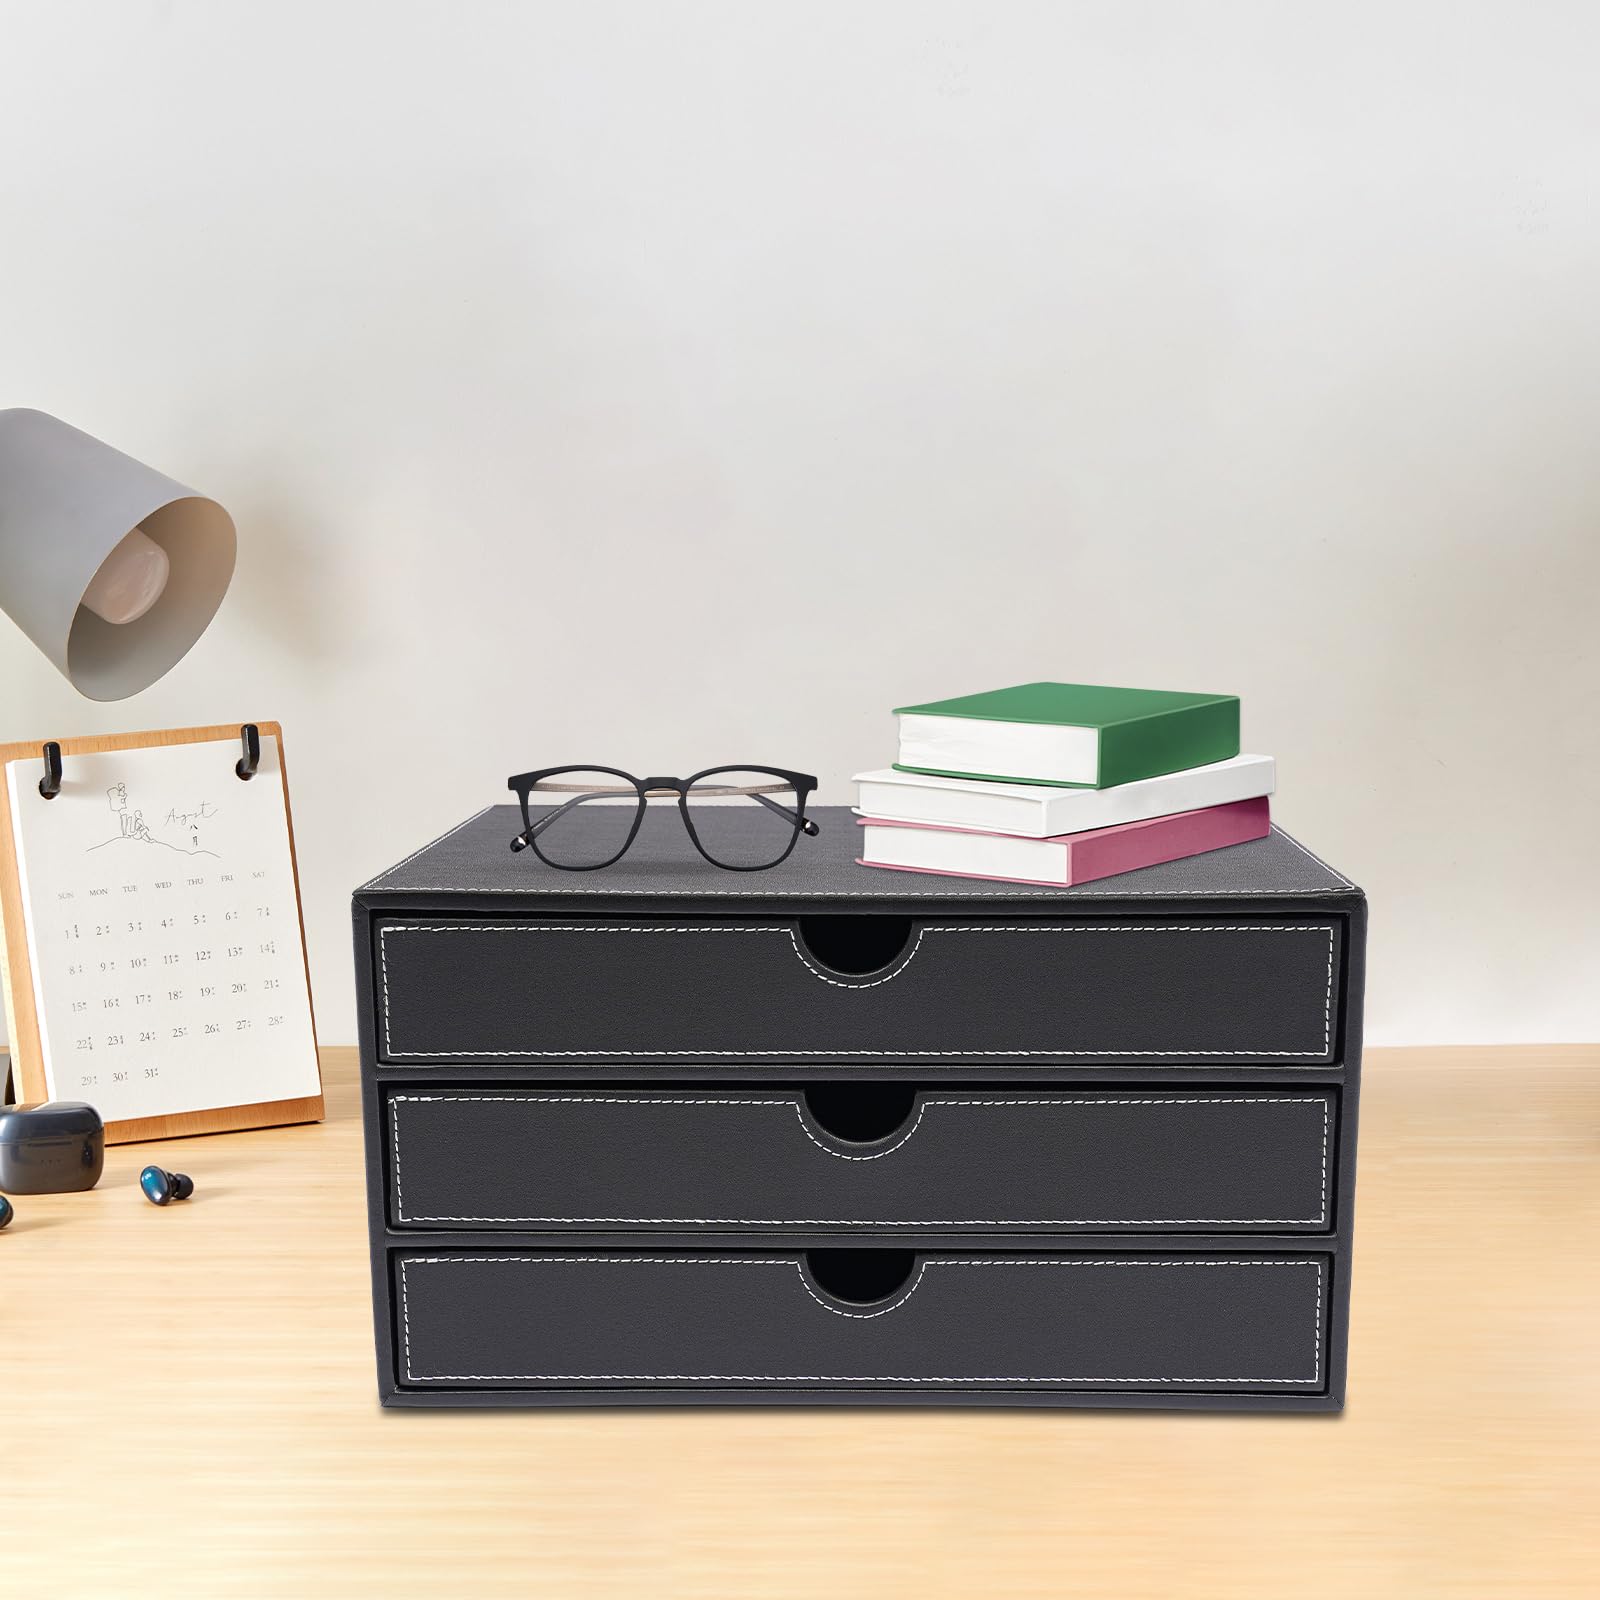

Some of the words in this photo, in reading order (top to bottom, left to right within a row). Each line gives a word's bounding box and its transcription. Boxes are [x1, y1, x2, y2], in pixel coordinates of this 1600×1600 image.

[165, 800, 219, 825] August
[89, 888, 108, 896] MON
[122, 884, 139, 893] TUE
[154, 881, 172, 889] WED
[186, 877, 204, 886] THU
[220, 874, 234, 883] FRI
[130, 958, 142, 969] 10
[163, 954, 173, 965] 11
[196, 950, 207, 961] 12
[227, 946, 239, 958] 13
[260, 943, 270, 953] 14
[71, 1001, 83, 1012] 15
[103, 998, 114, 1009] 16
[135, 994, 145, 1005] 17
[168, 990, 179, 1001] 18
[200, 987, 211, 997] 19
[231, 983, 243, 994] 20
[264, 979, 274, 990] 21
[76, 1039, 88, 1050] 22
[107, 1035, 119, 1046] 23
[139, 1032, 151, 1042] 24
[172, 1027, 184, 1038] 25
[204, 1024, 216, 1034] 26
[236, 1019, 247, 1031] 27
[268, 1015, 280, 1027] 28
[81, 1075, 92, 1087] 29
[113, 1072, 124, 1082] 30
[144, 1068, 154, 1079] 31
